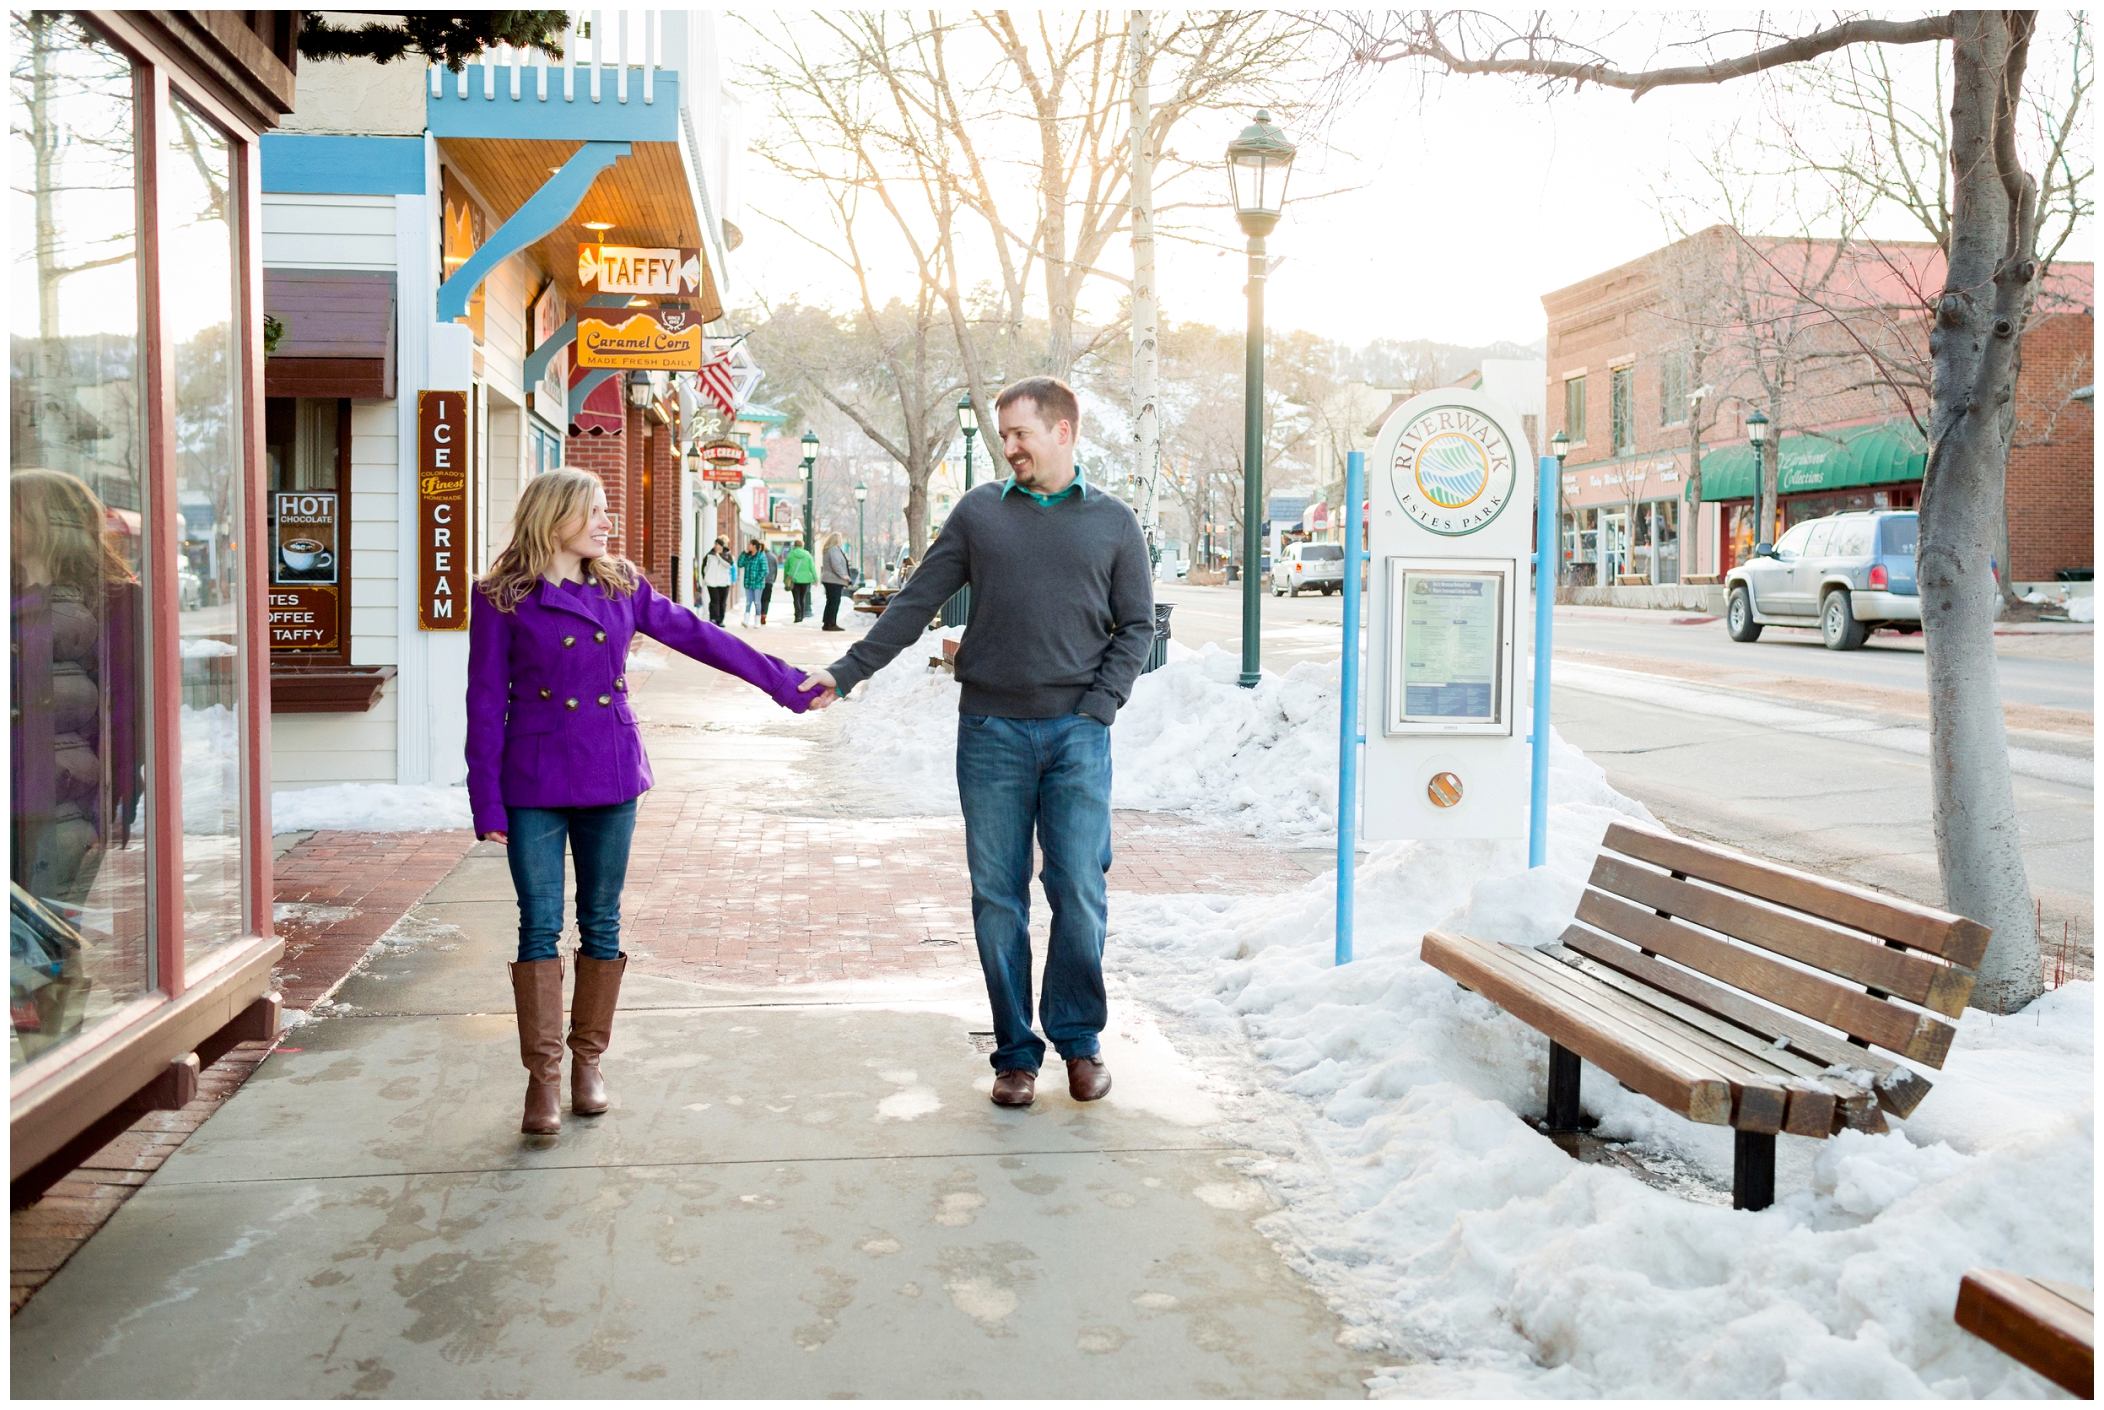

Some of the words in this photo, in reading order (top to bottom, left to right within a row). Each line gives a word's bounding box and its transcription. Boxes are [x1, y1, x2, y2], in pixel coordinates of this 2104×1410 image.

[603, 257, 676, 286] TAFFY
[586, 331, 650, 350] Caramel
[654, 334, 690, 350] Corn
[622, 358, 658, 366] FRESH
[662, 359, 693, 367] DAILY
[433, 400, 451, 468] ICE
[691, 416, 721, 439] BAR
[1394, 411, 1509, 473] RIVERWALK
[703, 448, 716, 460] ICE
[717, 447, 742, 459] CREAM
[421, 477, 464, 495] Finest
[1783, 468, 1825, 489] Collections
[281, 496, 333, 515] HOT
[1402, 494, 1450, 529] ESTES
[1462, 495, 1502, 528] PARK
[433, 504, 452, 618] CREAM
[273, 629, 324, 640] TAFFY
